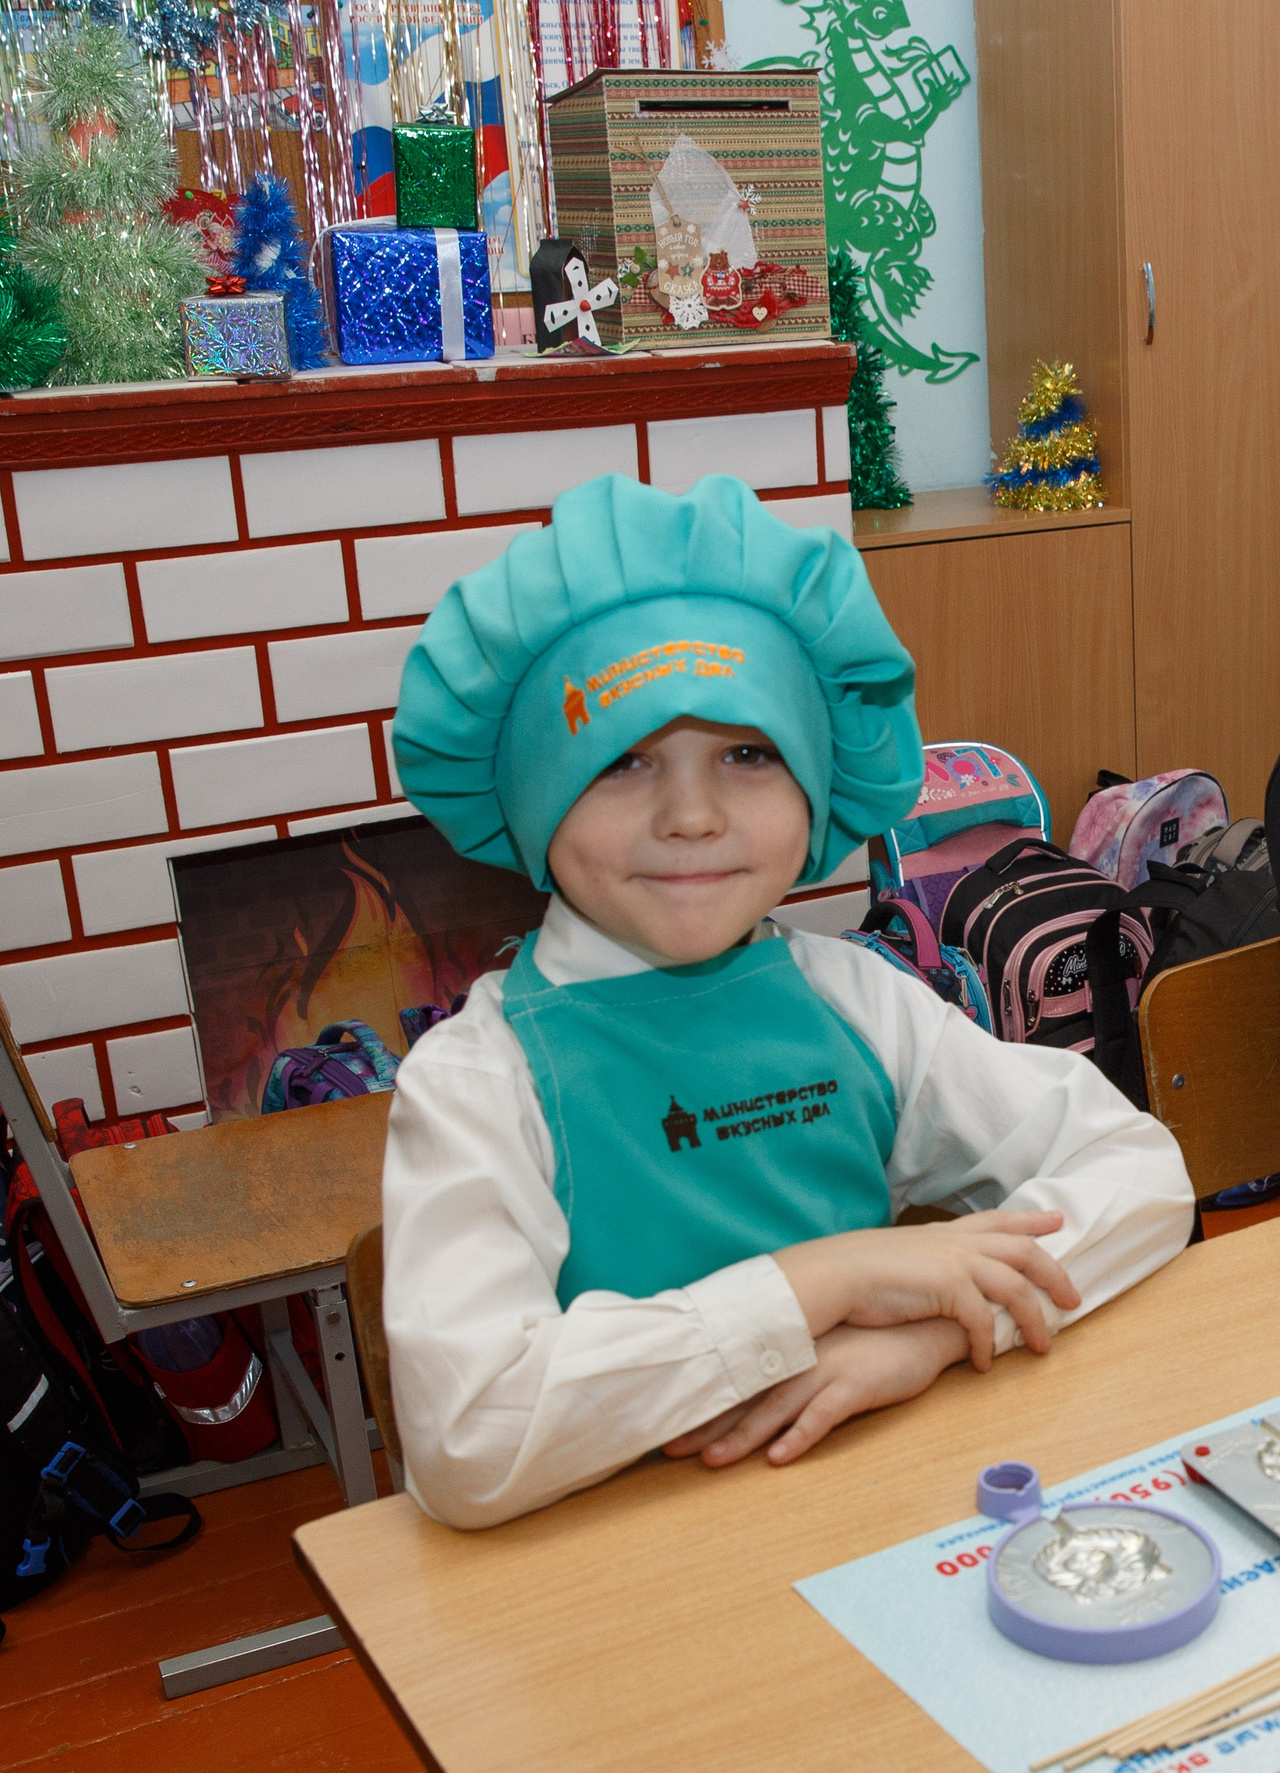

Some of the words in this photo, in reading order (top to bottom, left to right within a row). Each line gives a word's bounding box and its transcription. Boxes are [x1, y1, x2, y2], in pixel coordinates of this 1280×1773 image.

[658, 232, 684, 249] НОВЫЙ
[684, 233, 699, 248] ГОД
[663, 280, 700, 295] СКАЗКА
[586, 640, 745, 693] МИНИСТЕРСТВО
[702, 1079, 839, 1123] МИНИСТЕРСТВО
[715, 1109, 797, 1141] ВКУСНЫХ
[801, 1102, 831, 1124] ДЕЛ
